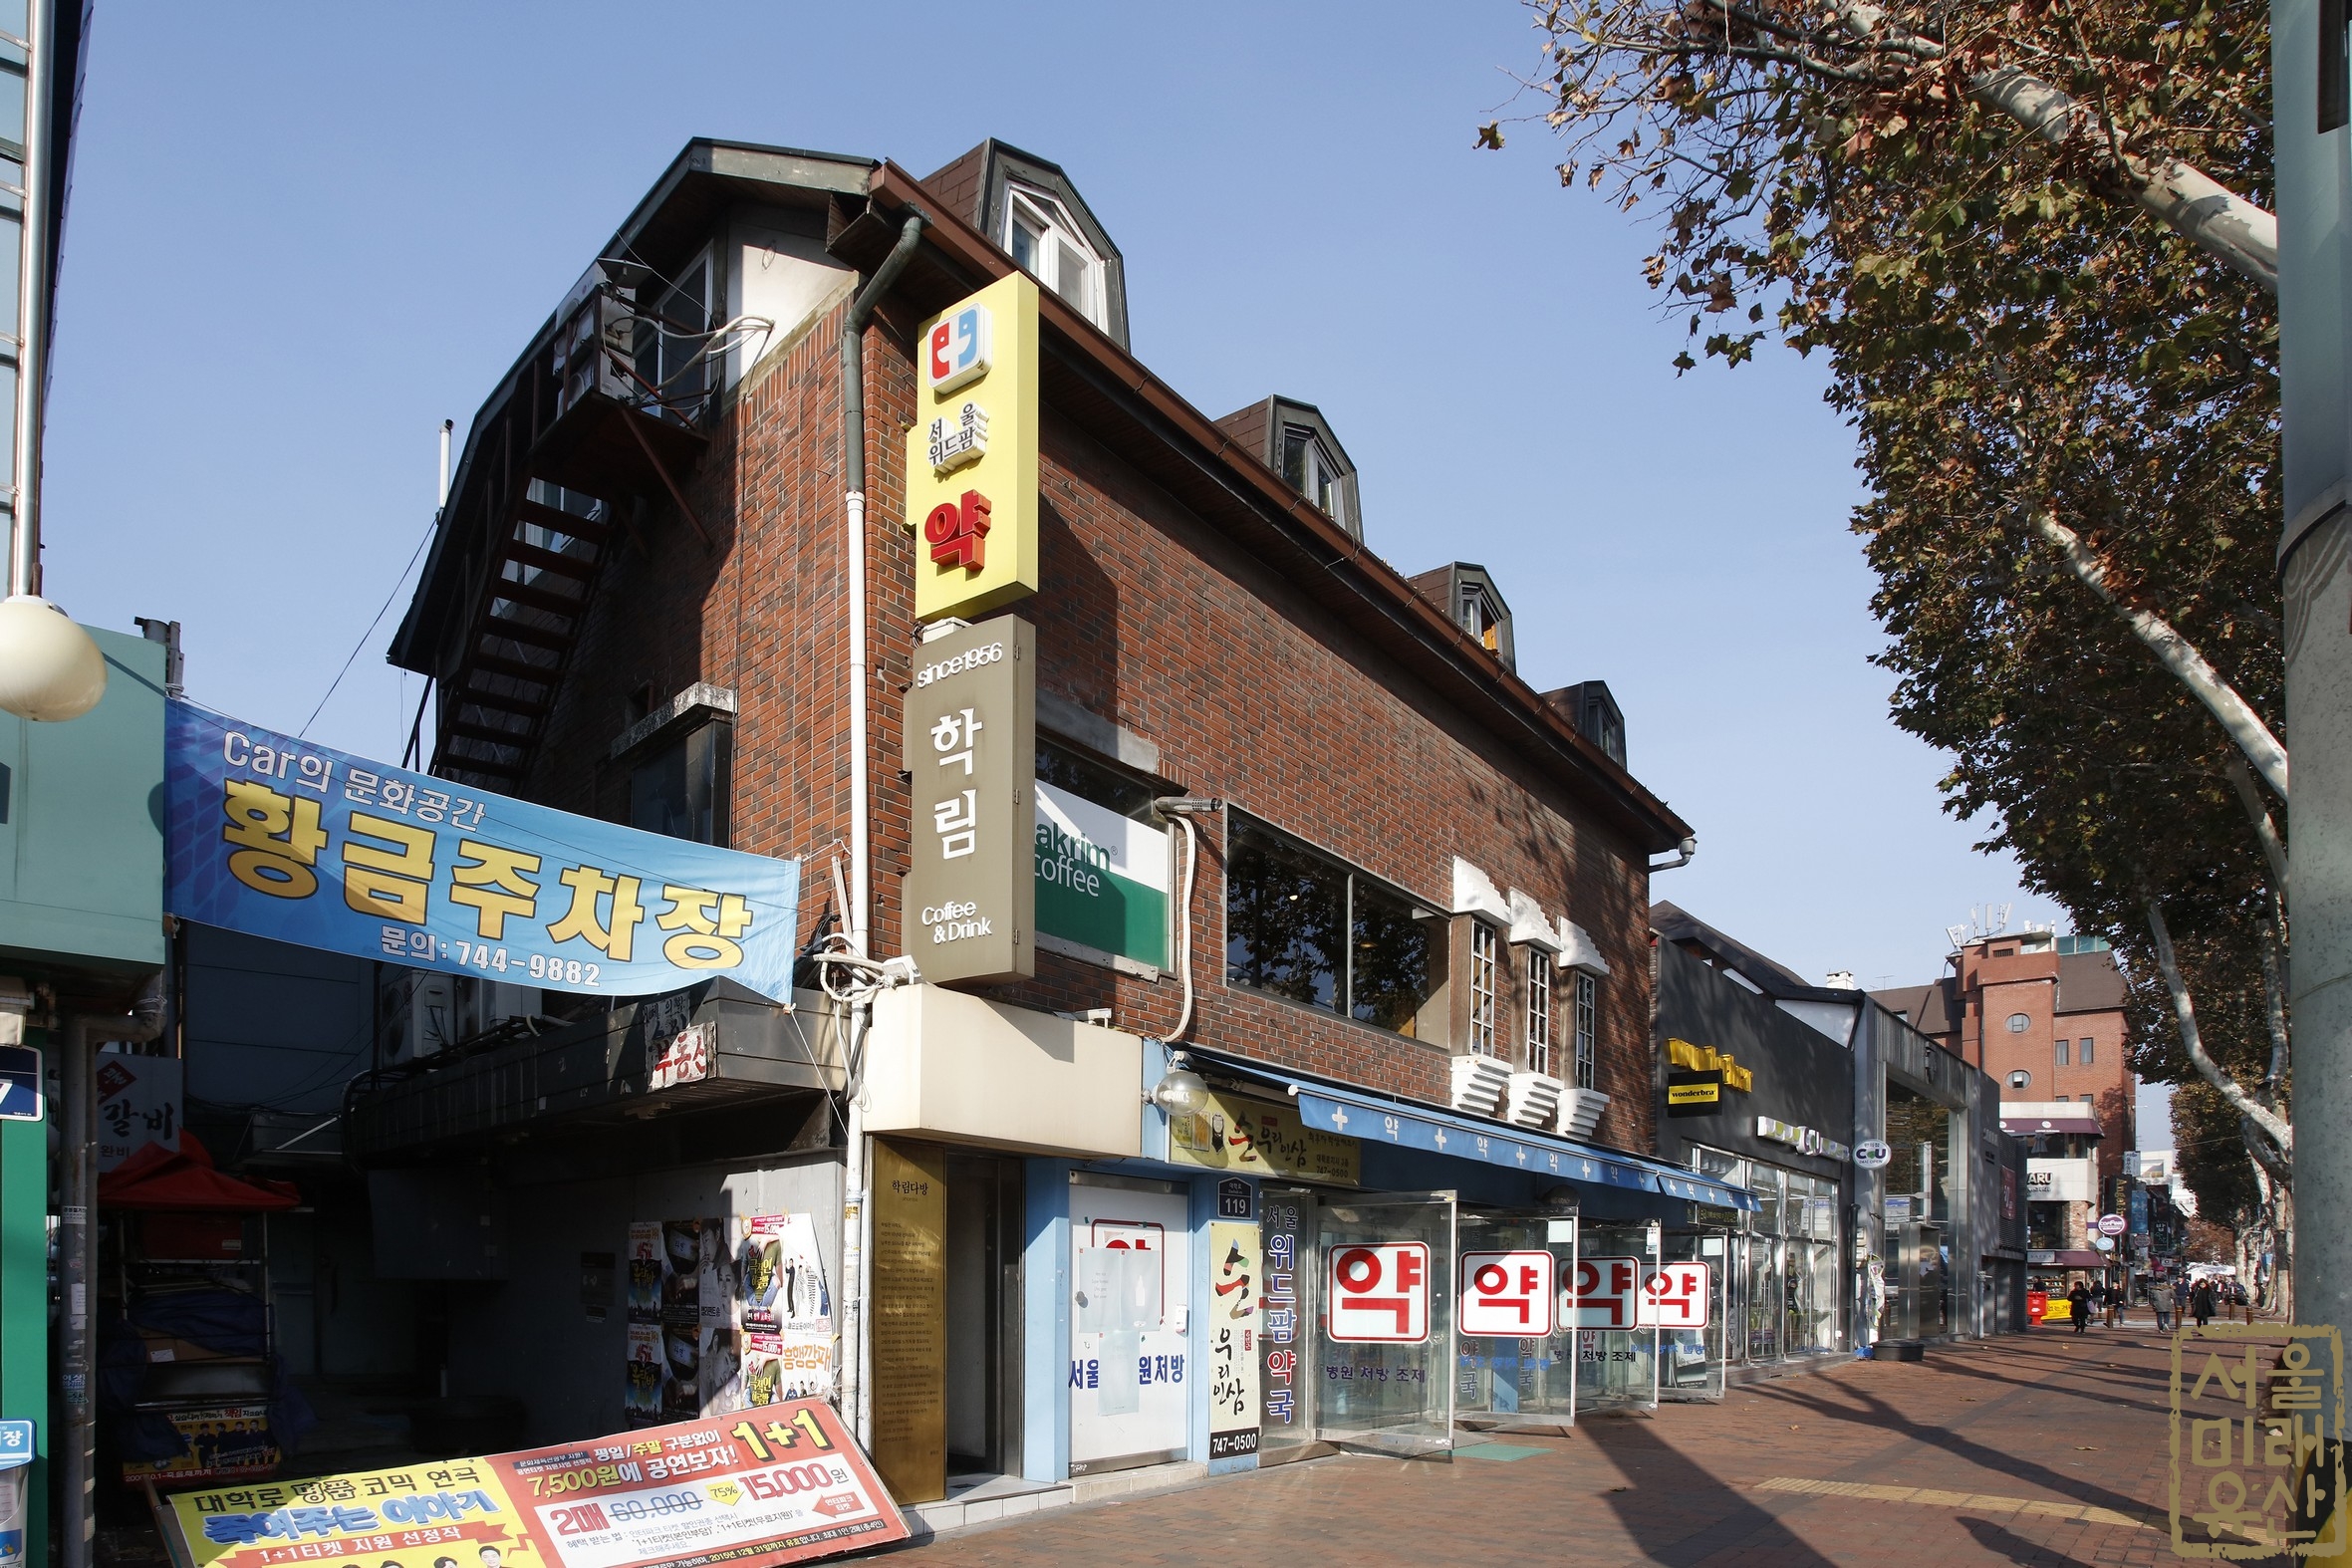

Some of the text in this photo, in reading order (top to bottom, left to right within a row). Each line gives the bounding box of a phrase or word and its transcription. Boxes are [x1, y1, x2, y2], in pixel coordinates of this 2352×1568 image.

[927, 426, 976, 467] 위드팜
[924, 488, 981, 572] 약
[223, 729, 486, 832] Car의 문화공간
[930, 707, 983, 860] 학림
[223, 778, 753, 971] 황금주차장
[921, 902, 977, 926] Coffee
[455, 938, 602, 988] 744-9882
[1672, 1089, 1715, 1099] wonderbra
[104, 1099, 173, 1141] 갈비
[1385, 1116, 1399, 1142] 약
[1476, 1137, 1488, 1159] 약
[1549, 1153, 1559, 1174] 약
[1610, 1166, 1619, 1182] 약
[1856, 1148, 1887, 1160] CU
[892, 1179, 928, 1195] 학림다방
[1225, 1198, 1246, 1214] 119
[1266, 1205, 1298, 1230] 서울
[1336, 1248, 1422, 1334] 약
[1474, 1263, 1538, 1324] 약
[1562, 1261, 1632, 1325] 약
[1645, 1271, 1697, 1318] 약
[1326, 1366, 1426, 1383] 병원 처방 조제
[1582, 1351, 1607, 1362] 처방
[1612, 1351, 1636, 1363] 조제
[3, 1430, 23, 1447] 장
[663, 1430, 722, 1451] 구분없이
[730, 1408, 835, 1464] 1+1
[1212, 1434, 1257, 1454] 747-0500
[194, 1466, 481, 1514] 대학로 명품 코믹 연극
[527, 1445, 739, 1498] 7,500원에 공연보자!
[383, 1489, 502, 1527] 이야기
[550, 1463, 850, 1536] 2매 60,000 75% 15,000 원
[259, 1526, 462, 1564] 1+1티켓 지원 선정작
